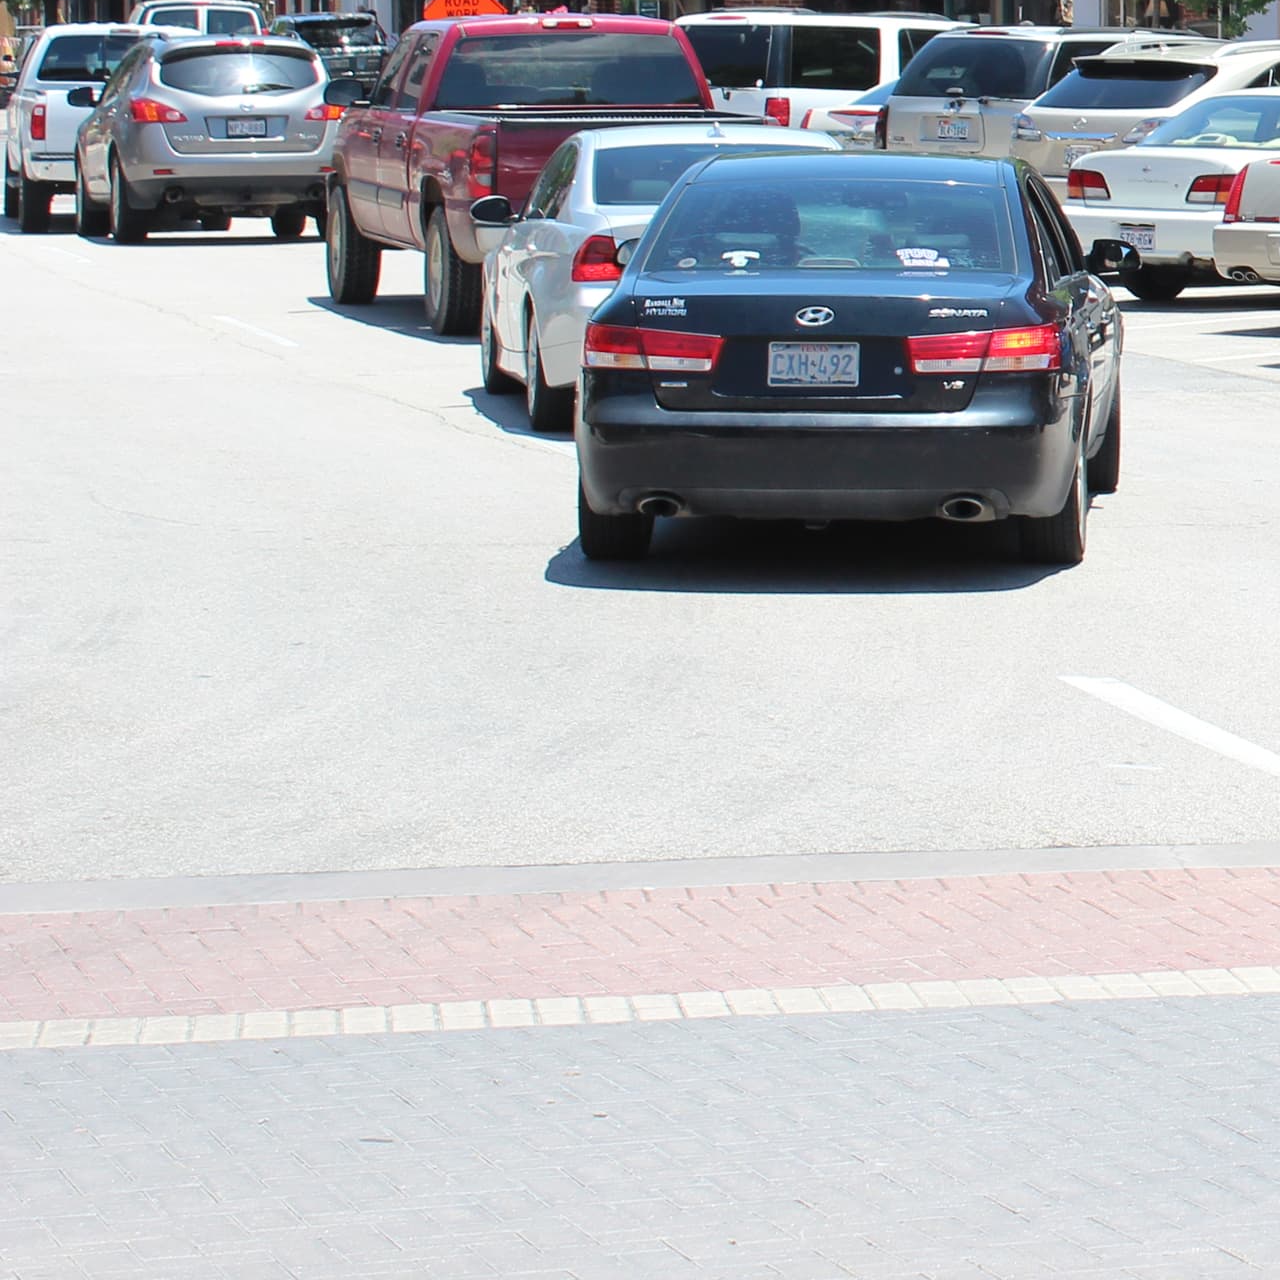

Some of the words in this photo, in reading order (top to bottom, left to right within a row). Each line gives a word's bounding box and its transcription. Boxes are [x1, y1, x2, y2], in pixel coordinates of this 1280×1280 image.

[446, 9, 479, 17] WORK
[645, 308, 687, 316] HYUNDAI
[928, 308, 988, 317] SONATA
[801, 344, 829, 352] TEXAS
[943, 380, 965, 390] V6
